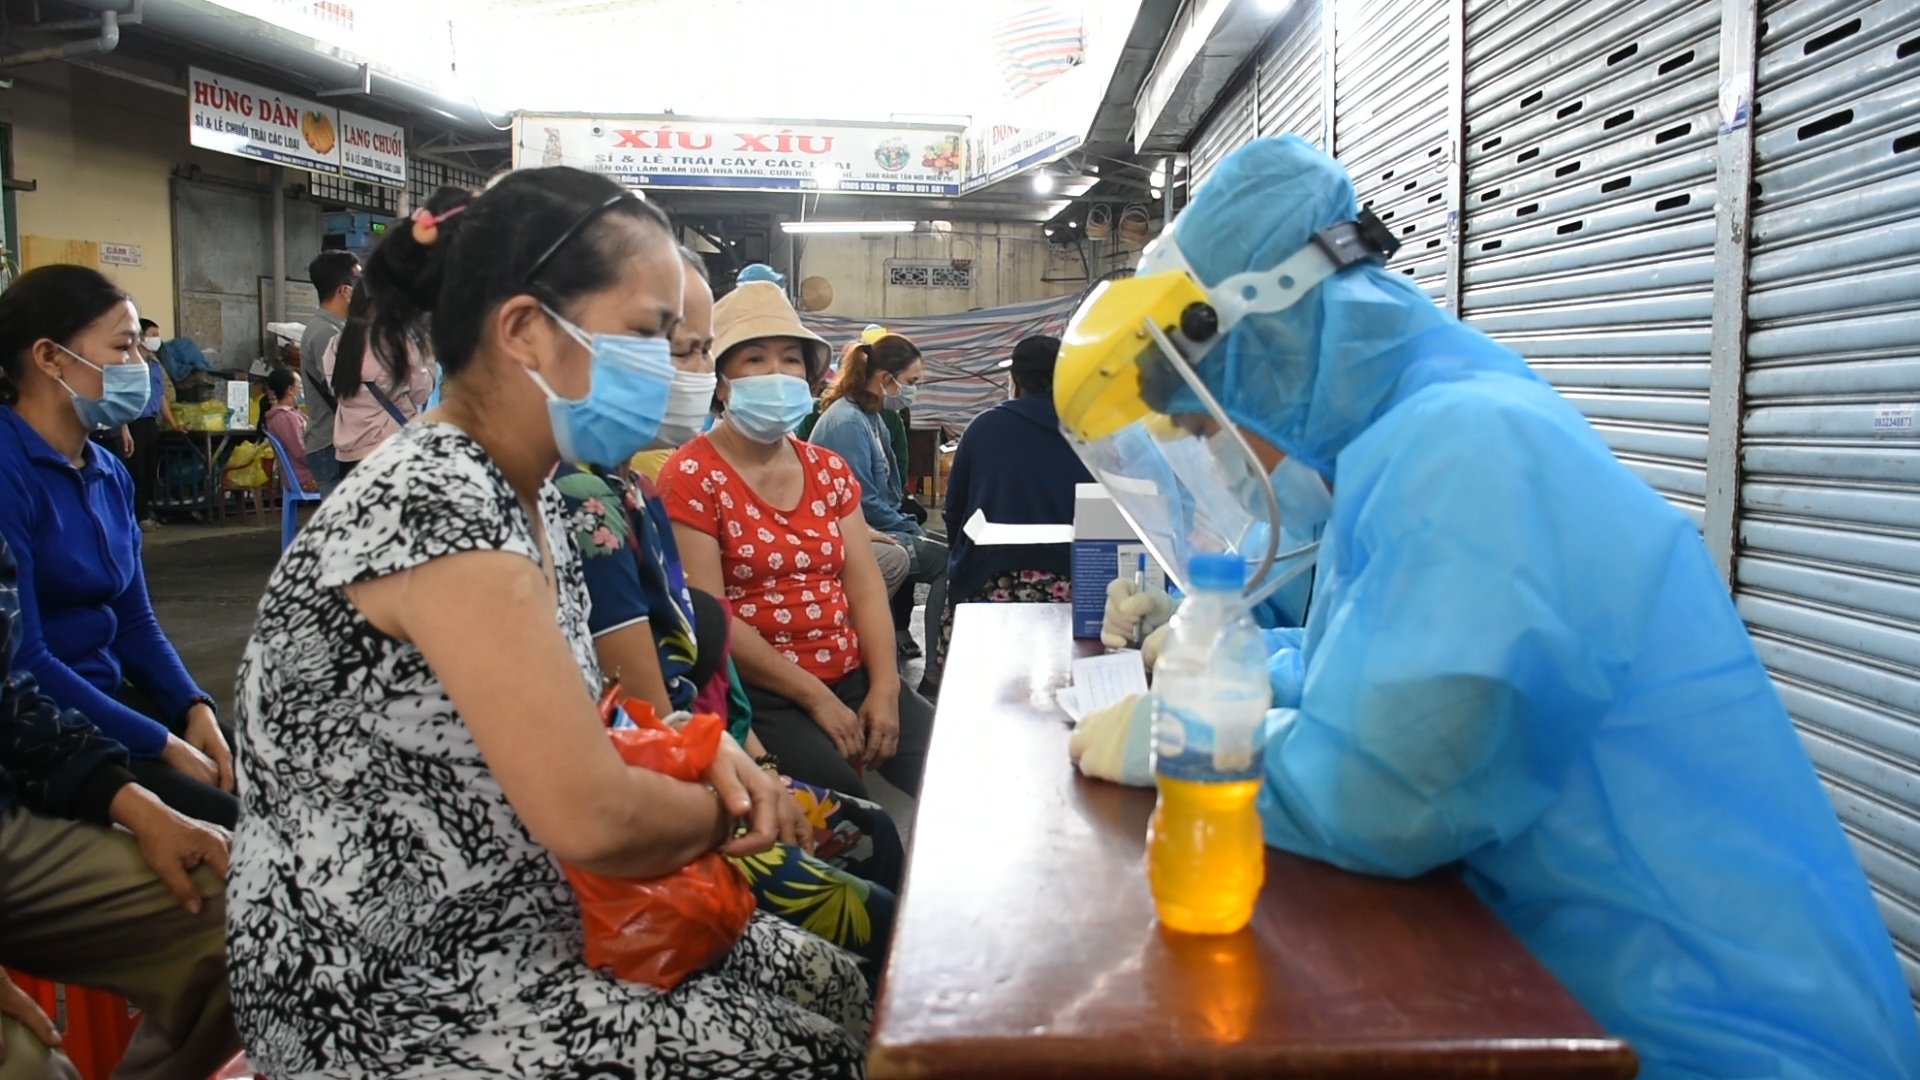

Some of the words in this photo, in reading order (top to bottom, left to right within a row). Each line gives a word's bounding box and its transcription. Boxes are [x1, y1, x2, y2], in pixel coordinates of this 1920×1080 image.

[194, 79, 253, 117] HÙNG
[258, 97, 298, 128] DÂN
[206, 117, 212, 129] &
[250, 127, 267, 144] TRÁI
[268, 131, 283, 148] CÁC
[284, 136, 300, 152] LOẠI
[344, 124, 370, 149] LANG
[373, 130, 402, 158] CHUỐI
[612, 125, 712, 151] XÍU
[733, 129, 835, 154] XÍU
[621, 154, 635, 163] &
[671, 155, 713, 166] TRÁI
[721, 156, 757, 167] CÂY
[765, 157, 803, 169] CÁC
